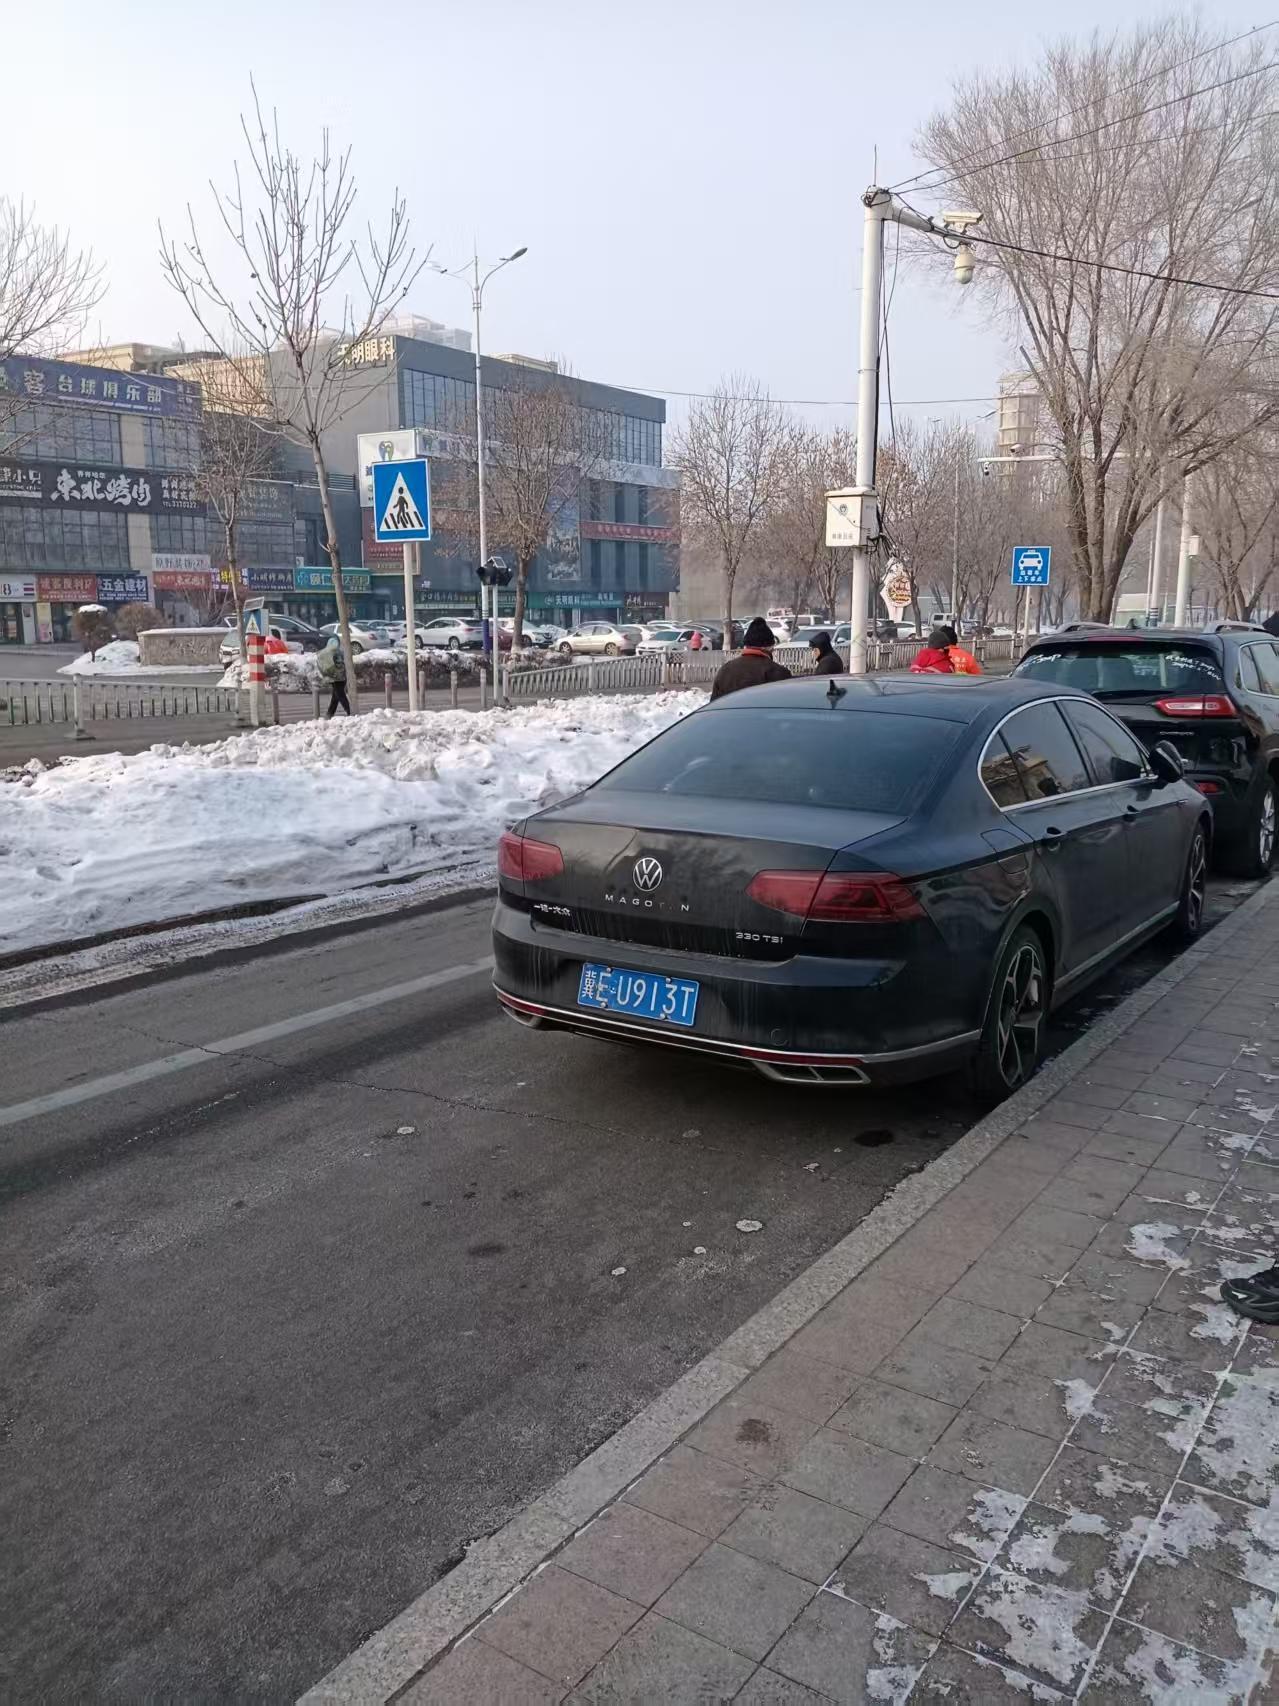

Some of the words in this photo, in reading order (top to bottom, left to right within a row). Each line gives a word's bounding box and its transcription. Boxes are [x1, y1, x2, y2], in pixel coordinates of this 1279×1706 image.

[102, 578, 147, 592] 五金建材
[735, 931, 760, 942] 330
